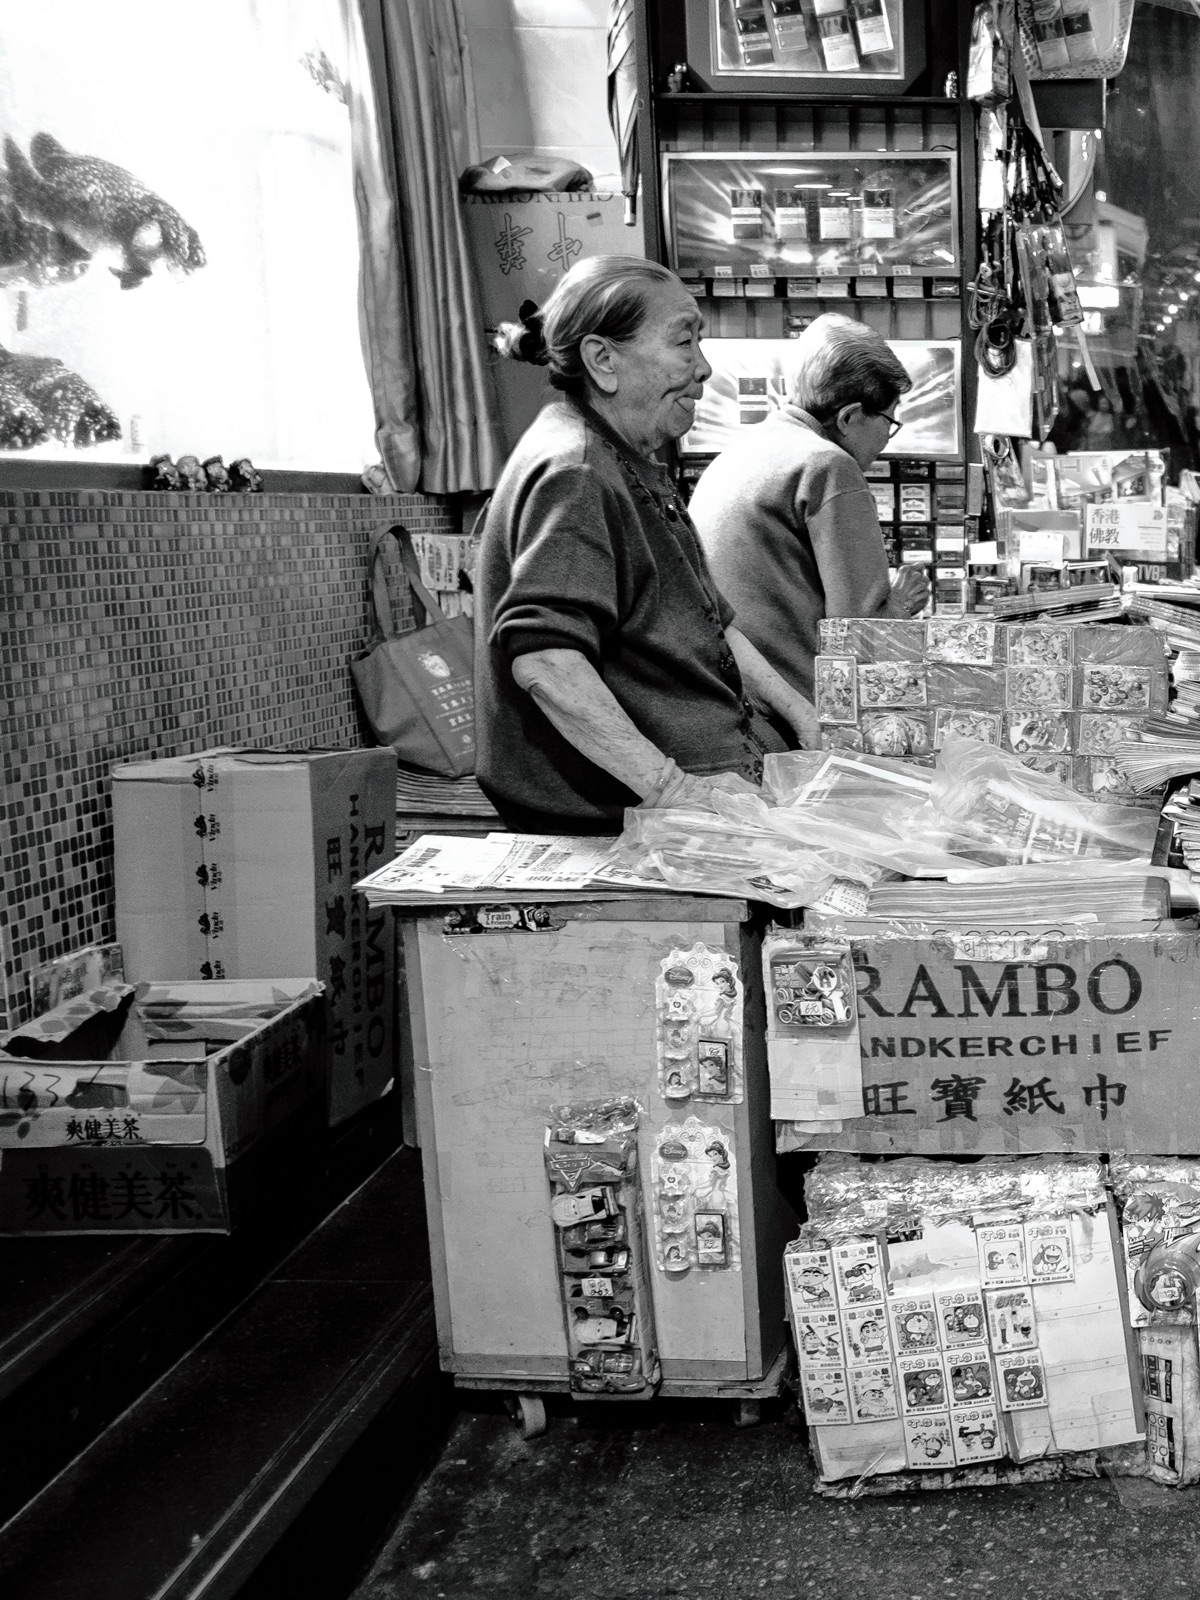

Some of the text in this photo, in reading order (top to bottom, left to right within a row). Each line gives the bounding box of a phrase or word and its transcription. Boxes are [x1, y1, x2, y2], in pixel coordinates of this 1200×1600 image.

[1091, 508, 1121, 524] 香港
[1089, 527, 1120, 545] 佛教
[484, 912, 512, 921] Train
[365, 820, 386, 1059] RMBO
[854, 958, 1142, 1018] RAMBO
[861, 1029, 1173, 1058] NDKERCHIEF
[863, 1073, 1128, 1123] 旺寶紙巾
[66, 1118, 141, 1140] 爽健美茶
[22, 1171, 195, 1221] 爽健美茶
